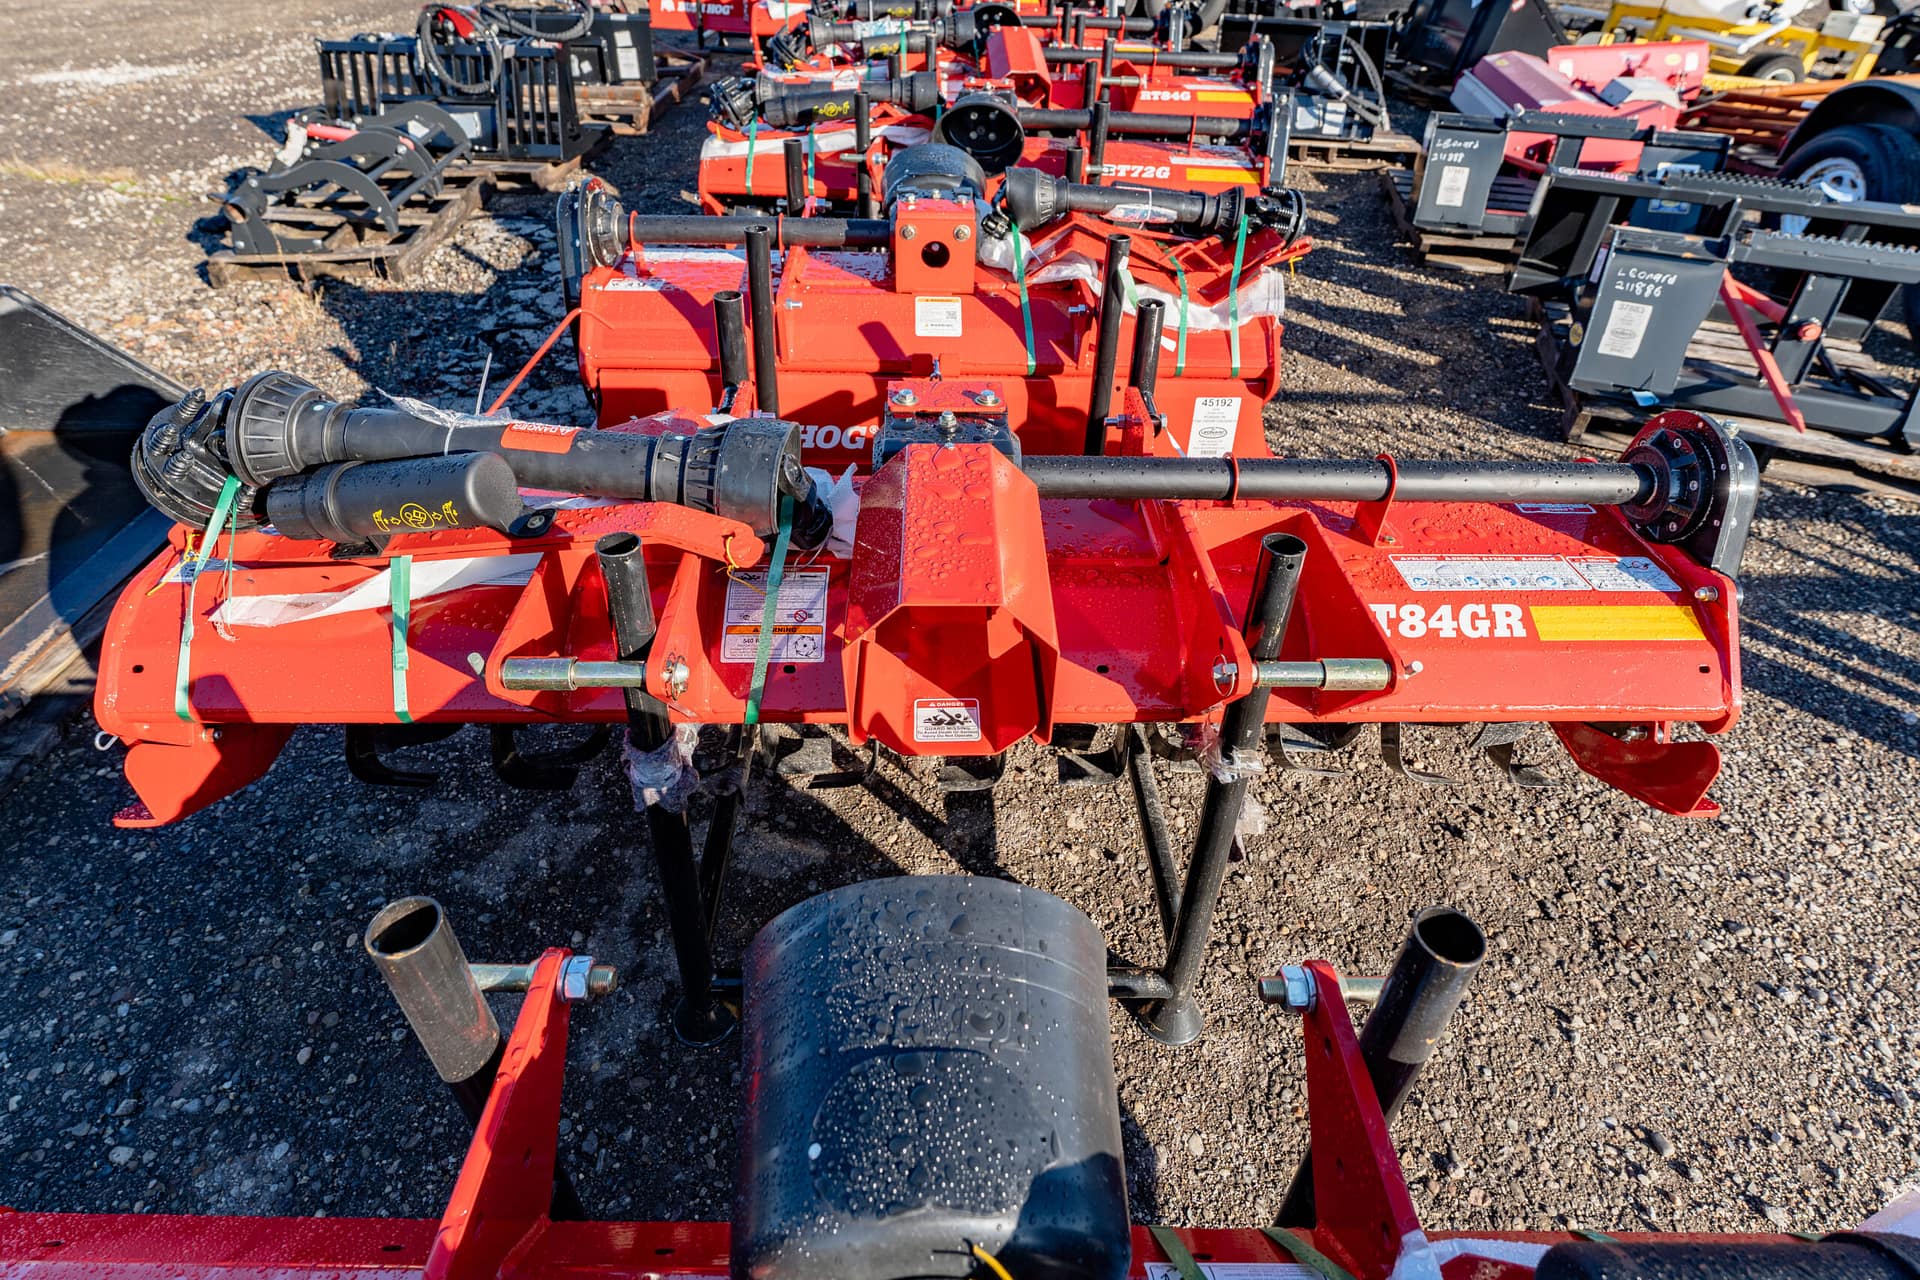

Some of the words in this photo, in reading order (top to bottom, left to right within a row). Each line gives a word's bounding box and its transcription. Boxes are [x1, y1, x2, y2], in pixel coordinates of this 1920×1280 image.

[1140, 90, 1191, 101] RT84G
[1614, 280, 1663, 298] 211886
[1200, 398, 1234, 407] 45192
[1368, 603, 1527, 639] T84GR
